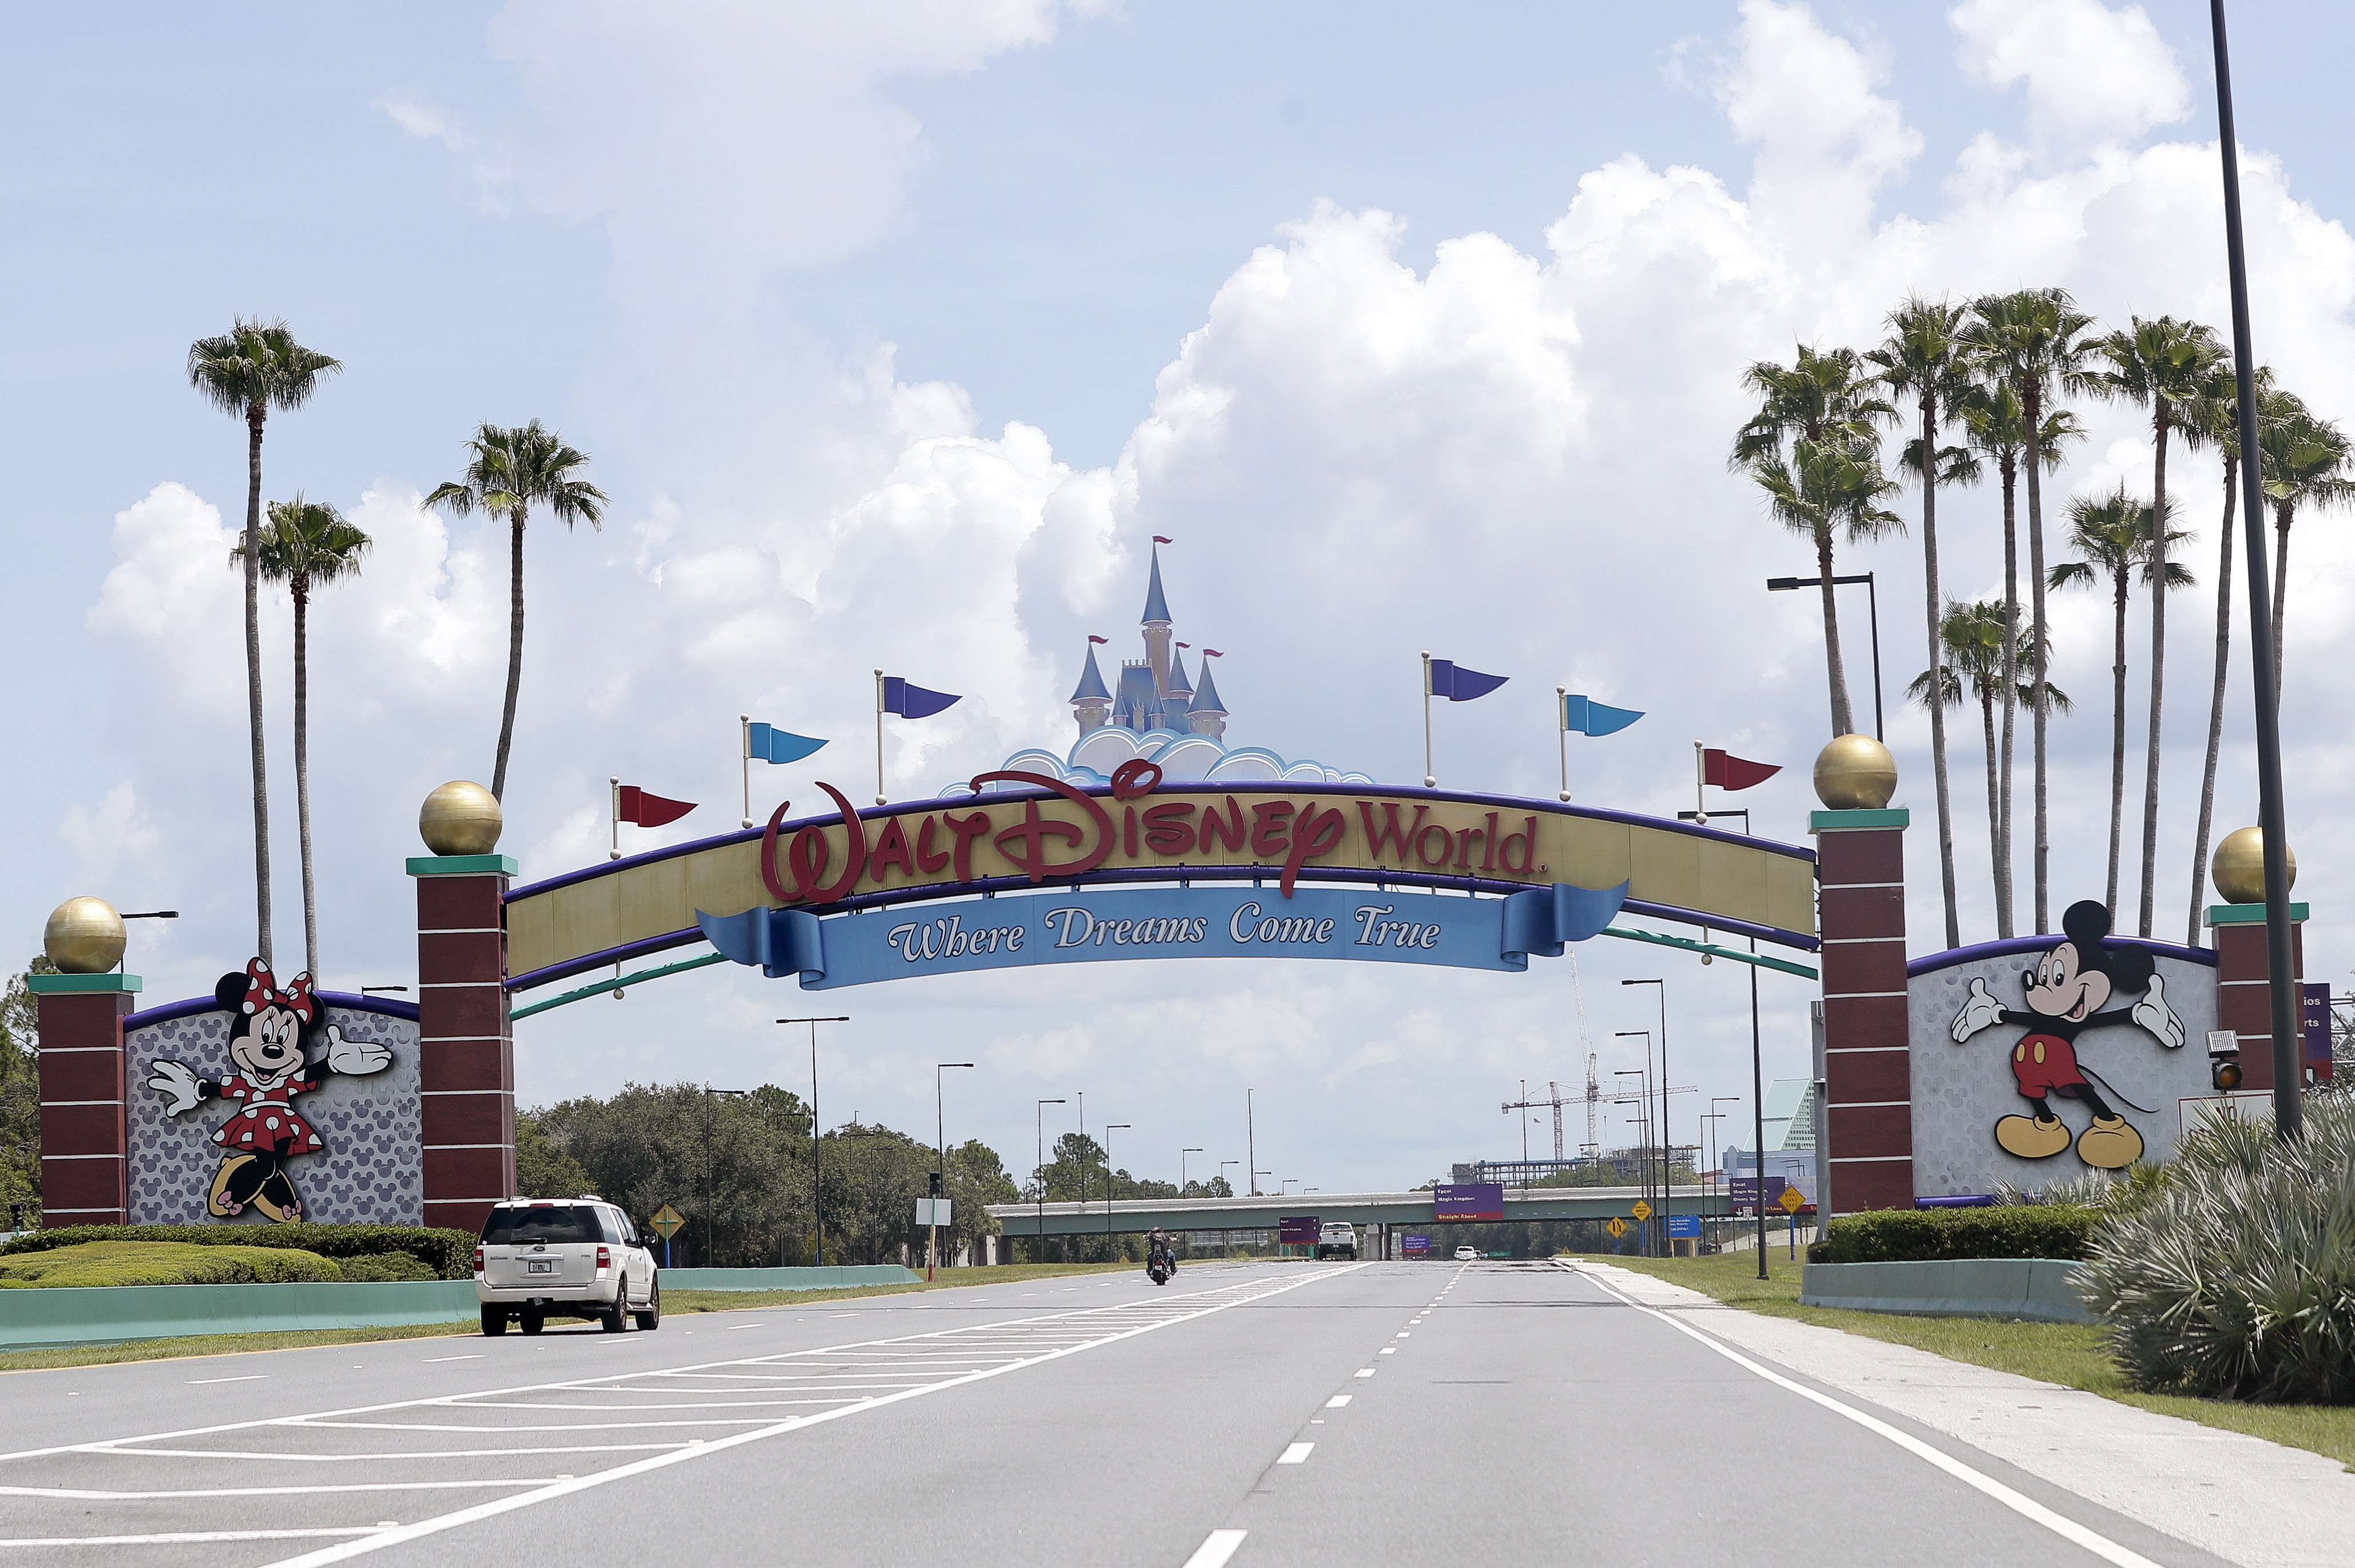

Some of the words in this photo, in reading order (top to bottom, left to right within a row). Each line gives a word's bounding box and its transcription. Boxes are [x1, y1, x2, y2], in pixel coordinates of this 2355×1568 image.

[887, 915, 1025, 963] Where
[1044, 907, 1208, 950] Dreams
[1228, 901, 1335, 944] Come
[1354, 904, 1441, 950] True
